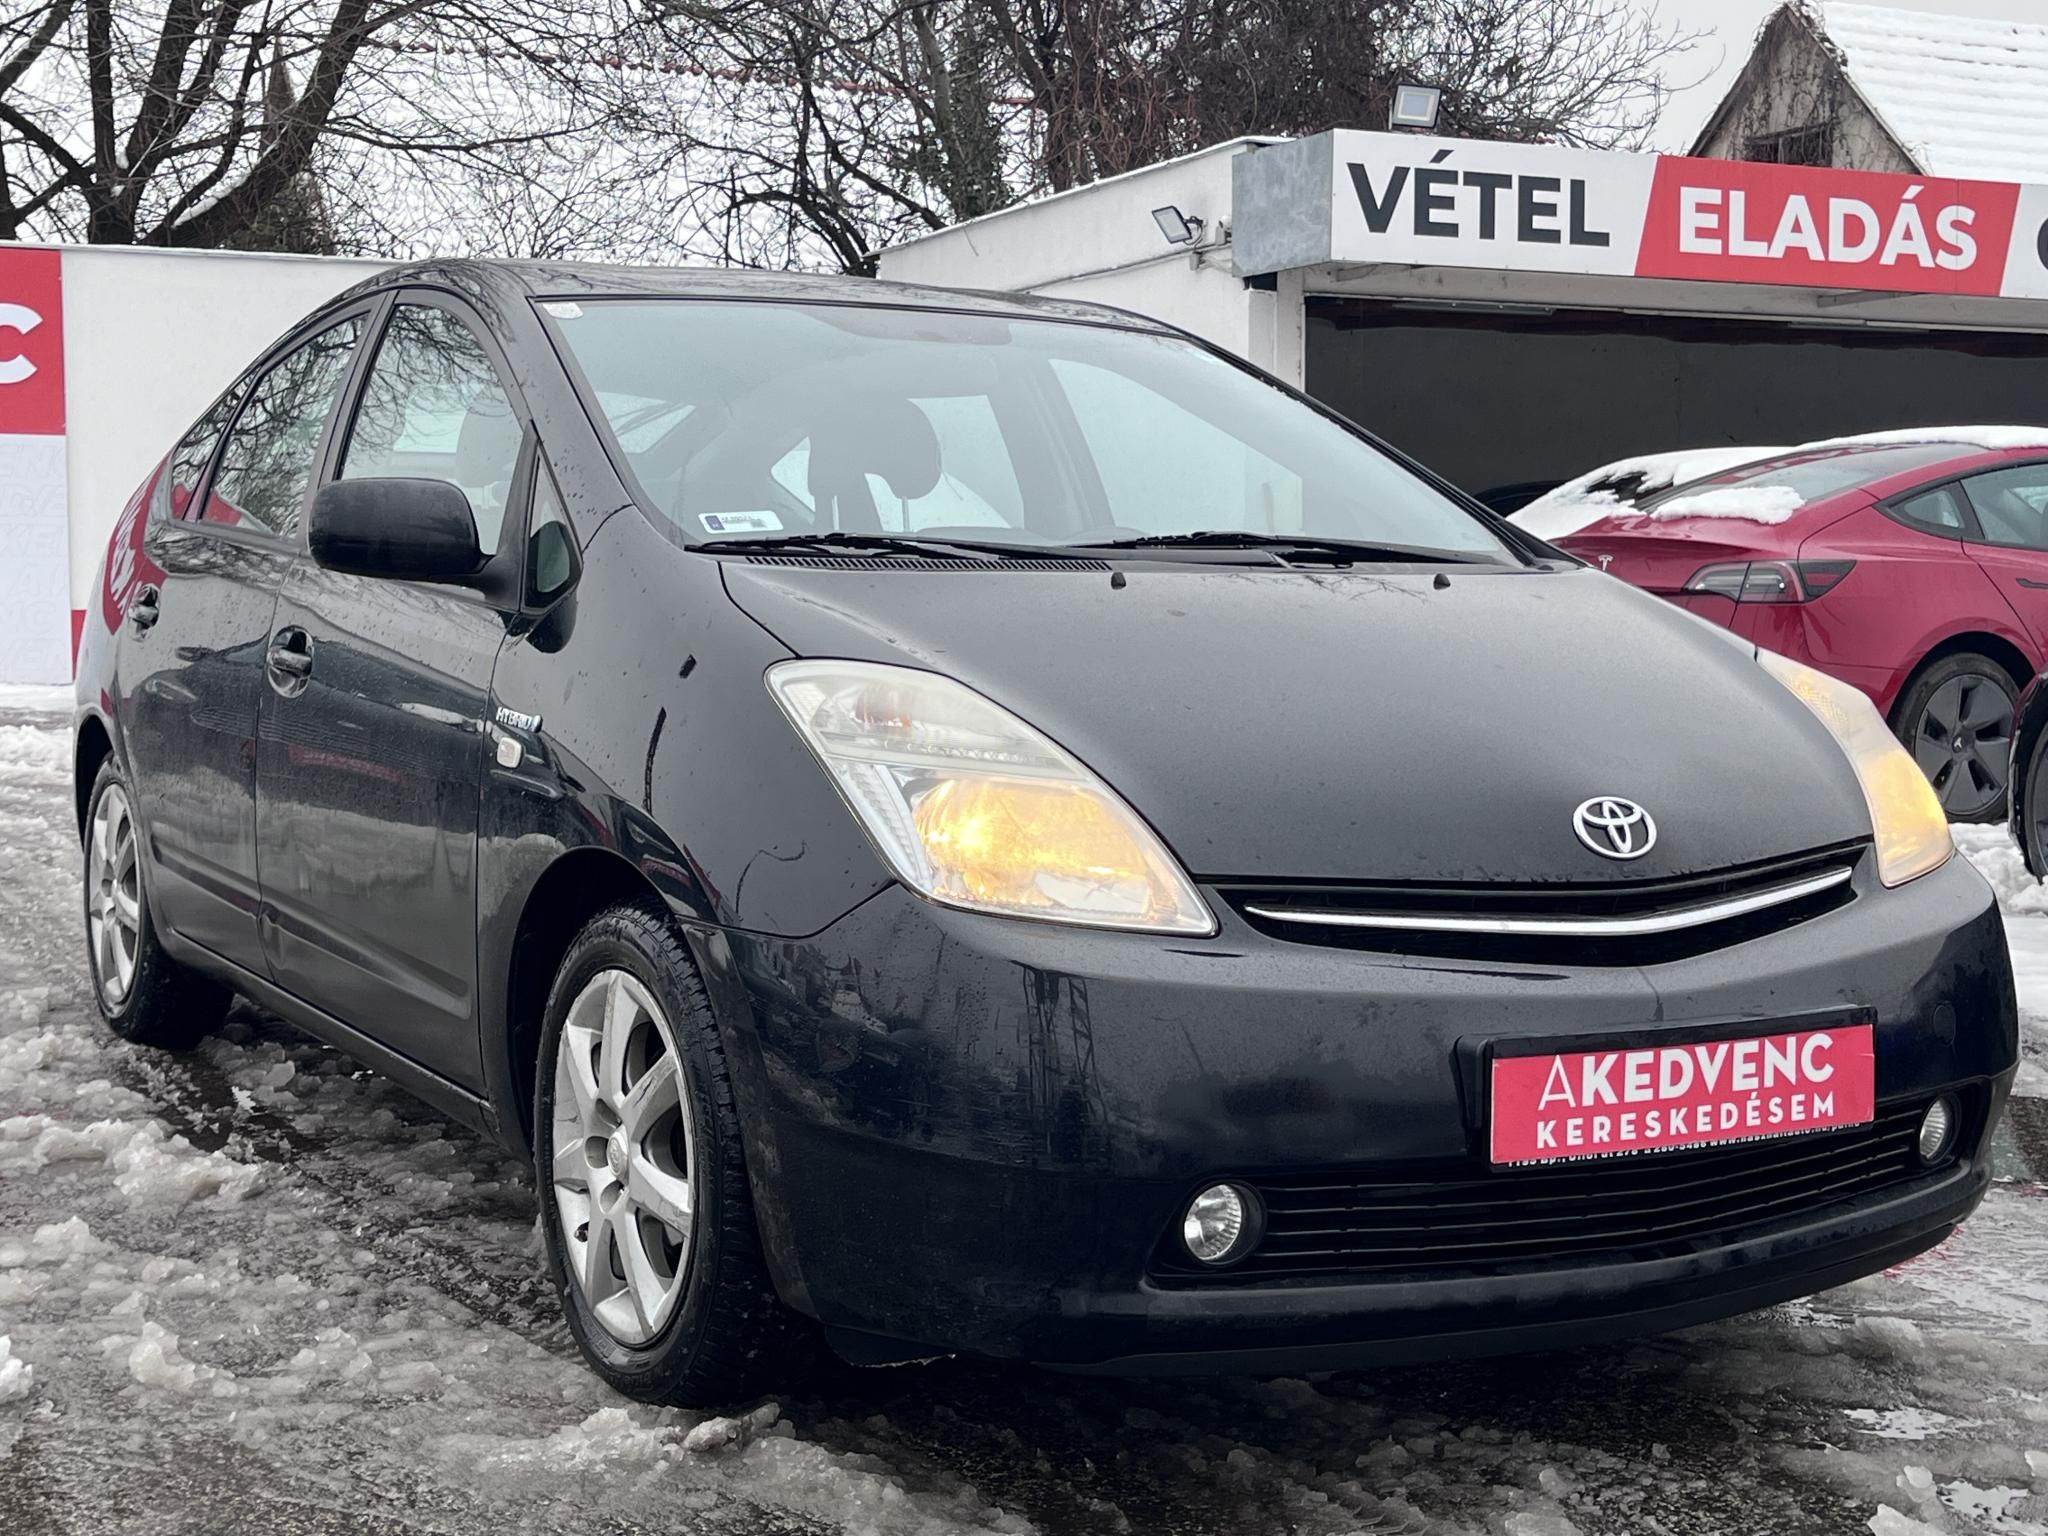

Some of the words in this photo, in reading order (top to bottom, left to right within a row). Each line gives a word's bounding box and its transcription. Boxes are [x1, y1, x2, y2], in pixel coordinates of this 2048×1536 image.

[1346, 149, 1610, 247] VÉTEL
[1678, 185, 1977, 269] ELADÁS
[495, 706, 533, 730] HYBRID
[1536, 1091, 1835, 1149] KERESKEDÉSEM
